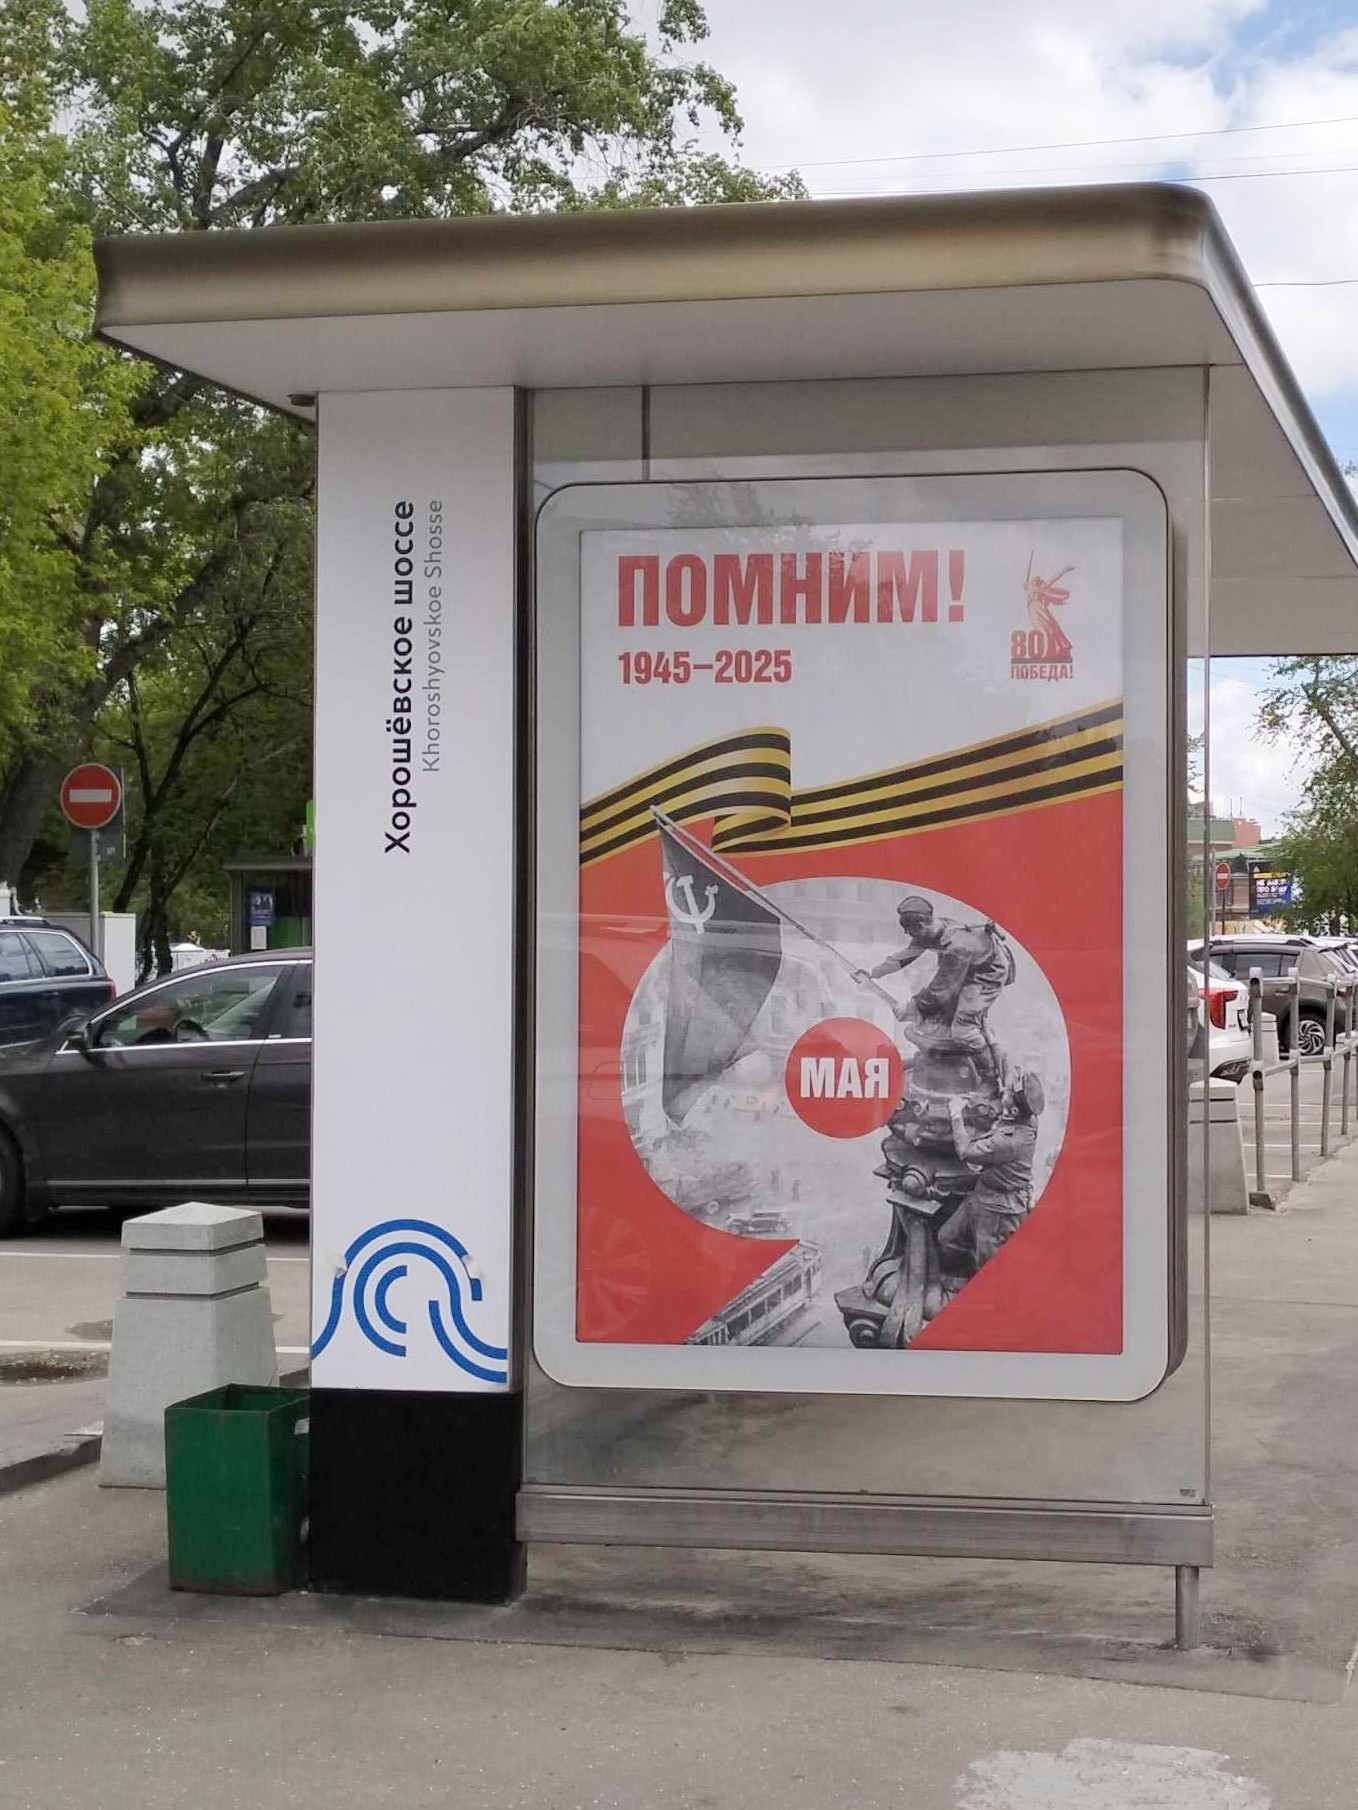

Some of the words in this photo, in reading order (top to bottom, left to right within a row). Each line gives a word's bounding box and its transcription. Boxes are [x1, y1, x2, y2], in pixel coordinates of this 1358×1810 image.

[394, 500, 414, 605] шоссе
[423, 499, 443, 578] Shosse
[617, 549, 965, 627] ПОМНИМ!
[422, 585, 445, 772] Khoroshyovskoe
[1010, 664, 1074, 682] ПОБЕДА!
[1011, 629, 1045, 660] 80
[384, 616, 417, 853] Хорошёвское
[800, 1056, 890, 1099] МАЯ
